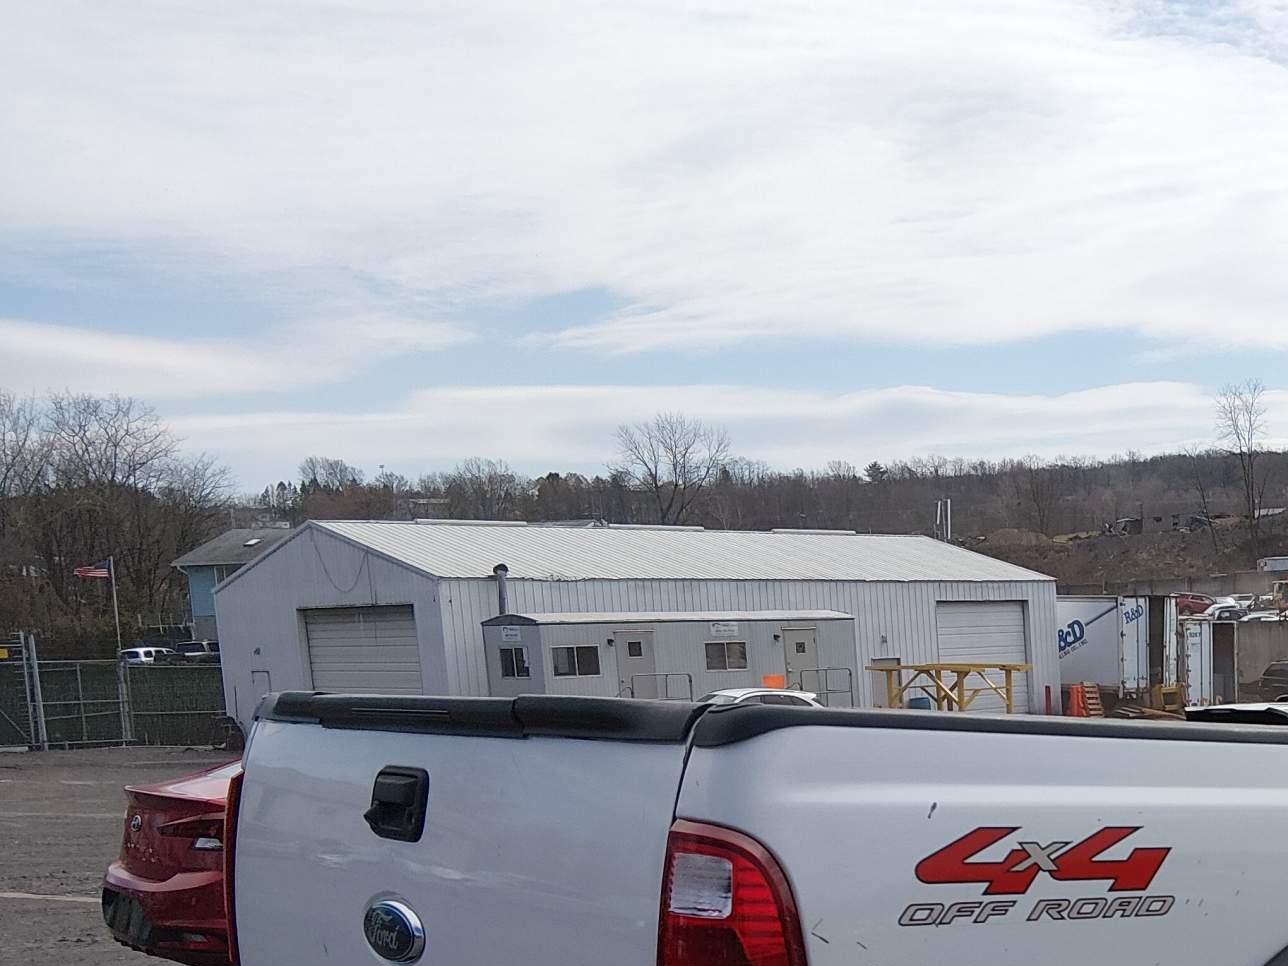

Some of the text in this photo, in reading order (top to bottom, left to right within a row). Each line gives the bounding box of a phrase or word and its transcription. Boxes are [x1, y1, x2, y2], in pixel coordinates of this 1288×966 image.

[1123, 604, 1144, 625] R&D
[1057, 619, 1085, 653] &D
[897, 895, 1176, 927] OFF ROAD
[367, 910, 399, 950] Ford
